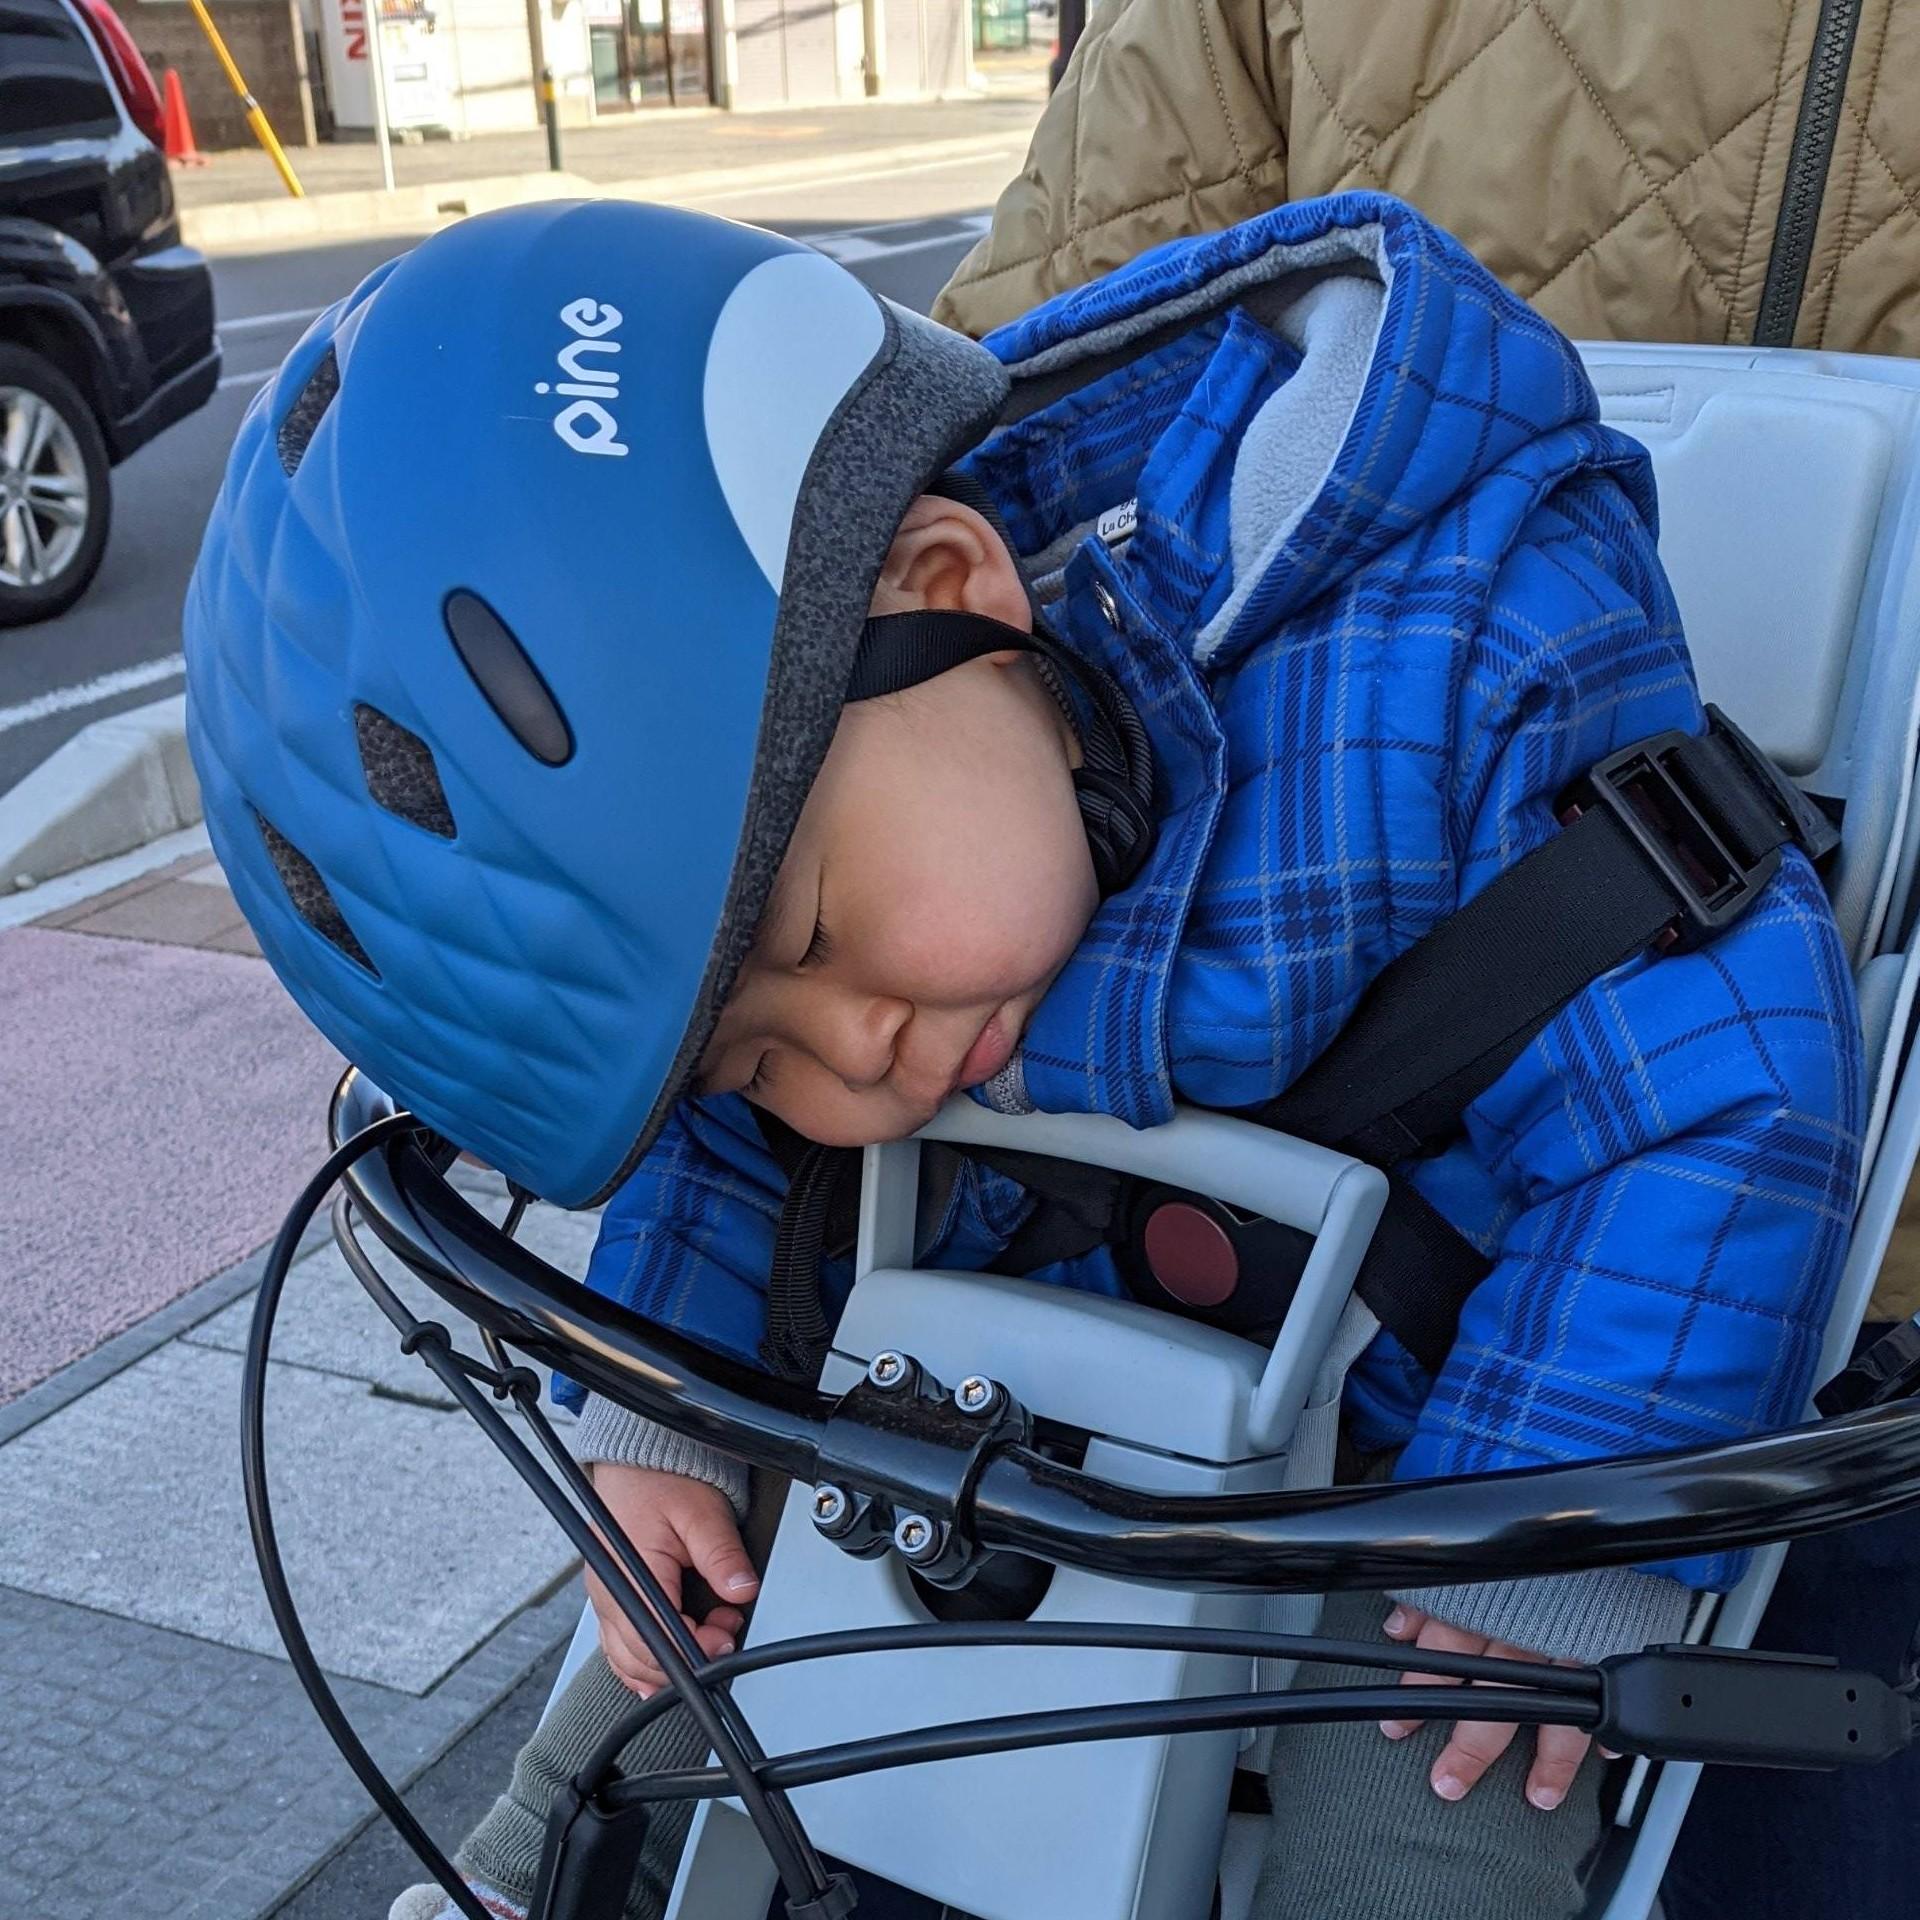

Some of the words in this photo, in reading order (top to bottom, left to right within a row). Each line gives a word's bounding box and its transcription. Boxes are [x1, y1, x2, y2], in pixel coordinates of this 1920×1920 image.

[341, 0, 368, 60] IN
[534, 297, 629, 456] pine
[1102, 522, 1115, 536] La
